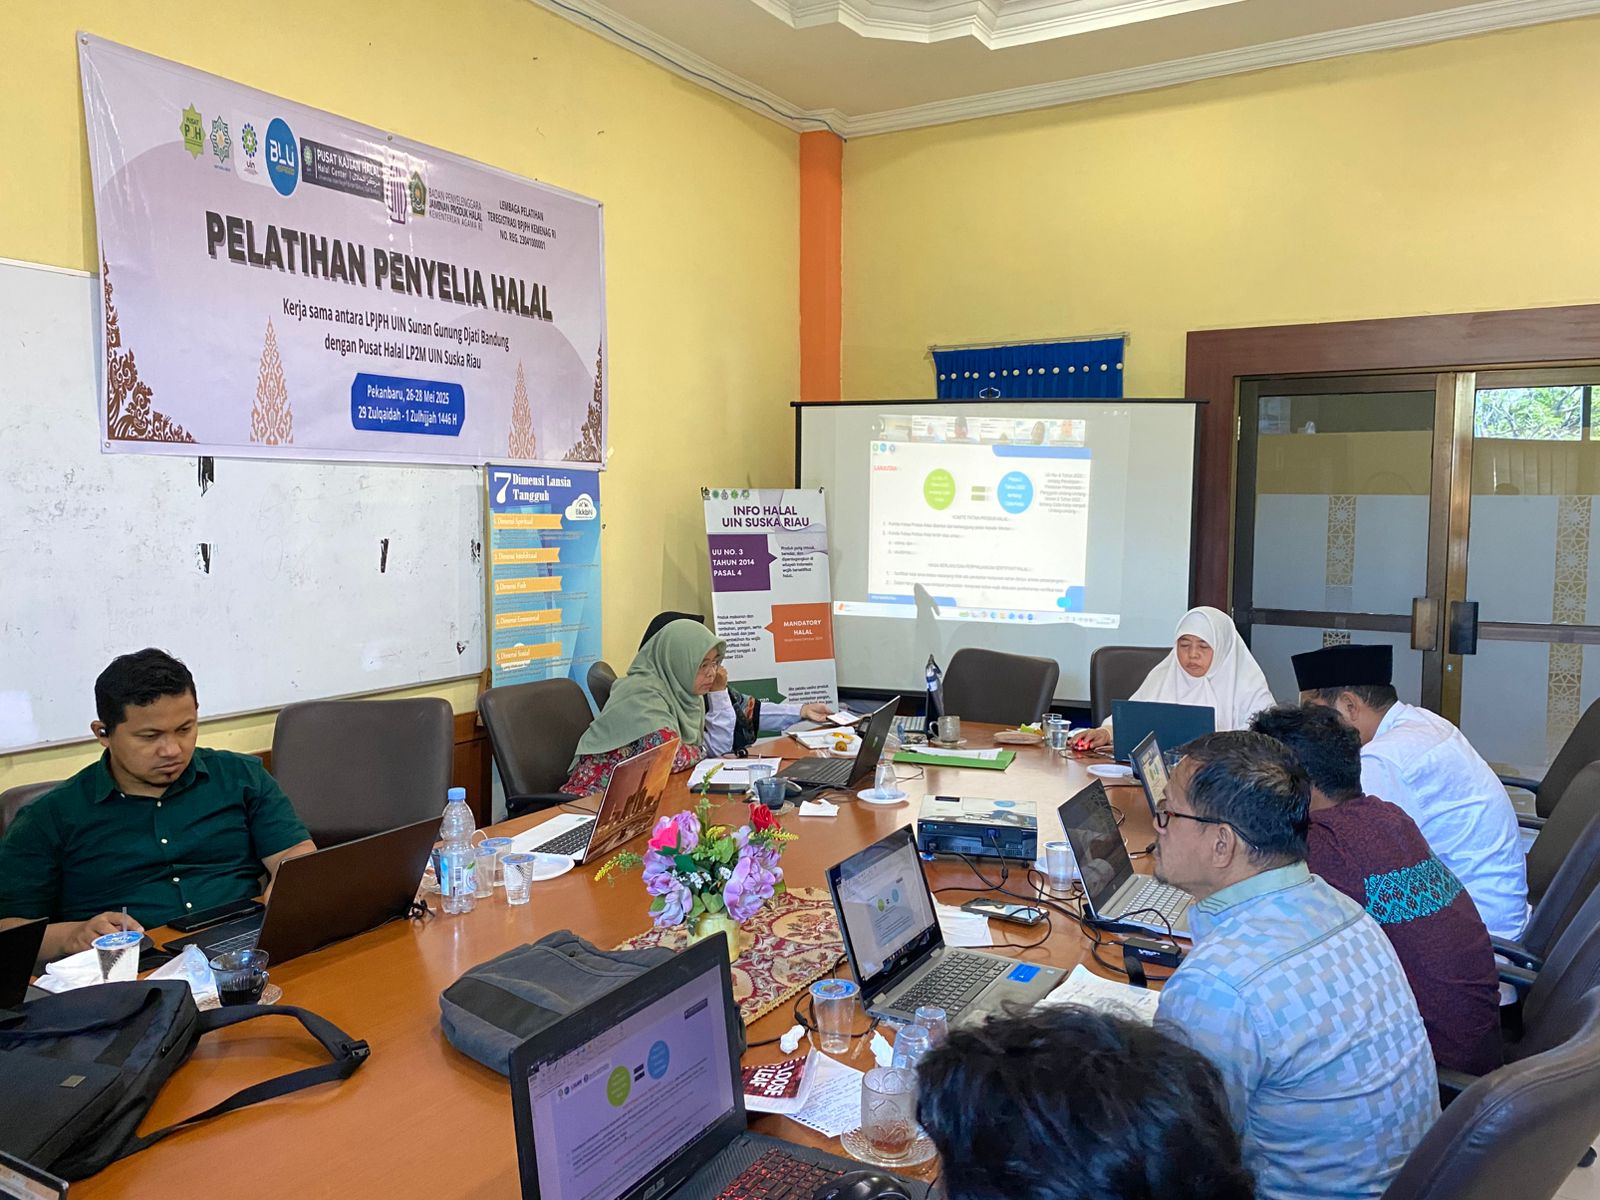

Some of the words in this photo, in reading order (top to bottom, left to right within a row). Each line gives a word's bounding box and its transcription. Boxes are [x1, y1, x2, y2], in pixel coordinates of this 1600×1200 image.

[269, 138, 295, 168] BLU
[317, 149, 337, 165] PUSAT
[487, 211, 517, 228] TEREGISTRASI
[500, 200, 521, 214] LEMBAGA
[521, 206, 544, 221] PELATIHAN
[500, 229, 509, 241] NO.
[206, 211, 367, 287] PELATIHAN
[373, 248, 488, 310] PENYELIA
[490, 273, 554, 322] HALAL
[283, 298, 307, 321] Kerja
[309, 307, 333, 321] sama
[335, 310, 364, 326] antara
[365, 313, 389, 332] LPJPH
[391, 315, 407, 333] UIN
[408, 318, 433, 337] Sunan
[433, 322, 463, 345] Gunung
[463, 326, 480, 347] Djati
[481, 330, 510, 352] Bandung
[324, 333, 357, 357] dengan
[358, 338, 382, 356] Pusat
[383, 341, 404, 360] Halal
[405, 344, 427, 362] LP2M
[428, 347, 443, 364] UIN
[444, 350, 465, 367] Suska
[466, 353, 482, 369] Riau
[367, 384, 405, 403] Pekanbaru,
[406, 387, 423, 402] 26-28
[423, 390, 435, 403] Mei
[436, 391, 449, 405] 2025
[358, 406, 367, 419] 29
[367, 406, 401, 424] Zulqaidah
[438, 411, 451, 425] 1446
[452, 413, 458, 425] H
[494, 471, 511, 504] 7
[512, 473, 545, 486] Dimensi
[546, 475, 572, 488] Lansia
[512, 488, 550, 503] Tangguh
[733, 506, 760, 516] INFO
[763, 505, 798, 516] HALAL
[722, 517, 743, 528] UIN
[745, 517, 781, 528] SUSKA
[784, 517, 810, 527] RIAU
[723, 548, 738, 556] NO.
[738, 558, 755, 566] 2014
[713, 569, 736, 577] PASAL
[783, 619, 822, 628] MANDATORY
[749, 1067, 776, 1089] LEAF
[764, 1064, 795, 1097] LOOSE
